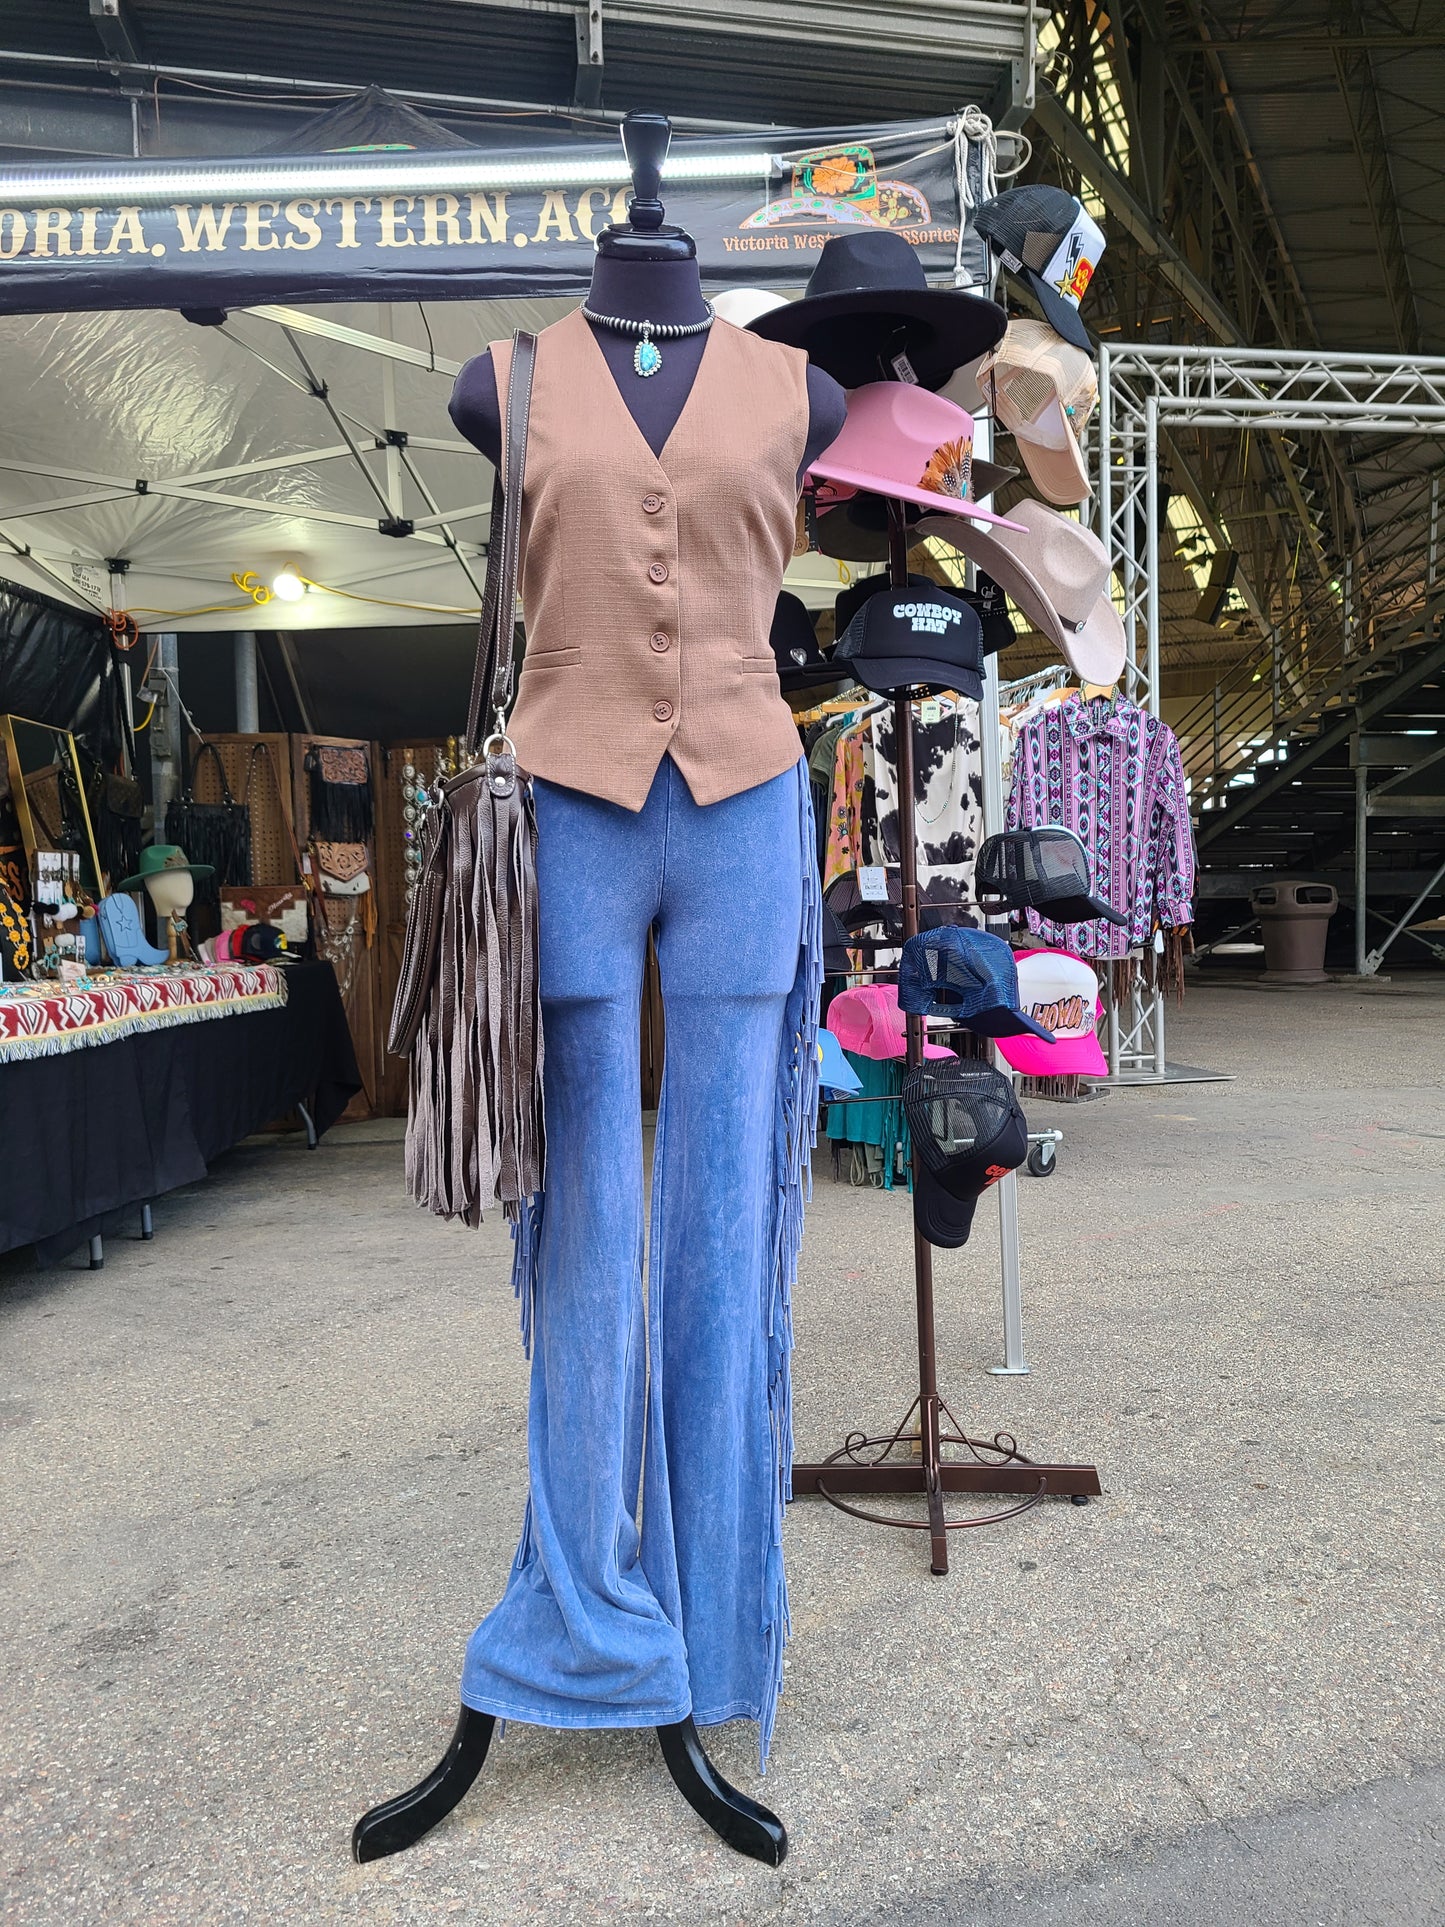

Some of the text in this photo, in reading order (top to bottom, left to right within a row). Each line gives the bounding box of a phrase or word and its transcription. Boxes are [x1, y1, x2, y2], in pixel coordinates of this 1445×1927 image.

[723, 234, 790, 252] Victoria
[893, 603, 963, 625] COWBOY
[911, 617, 948, 635] HAT
